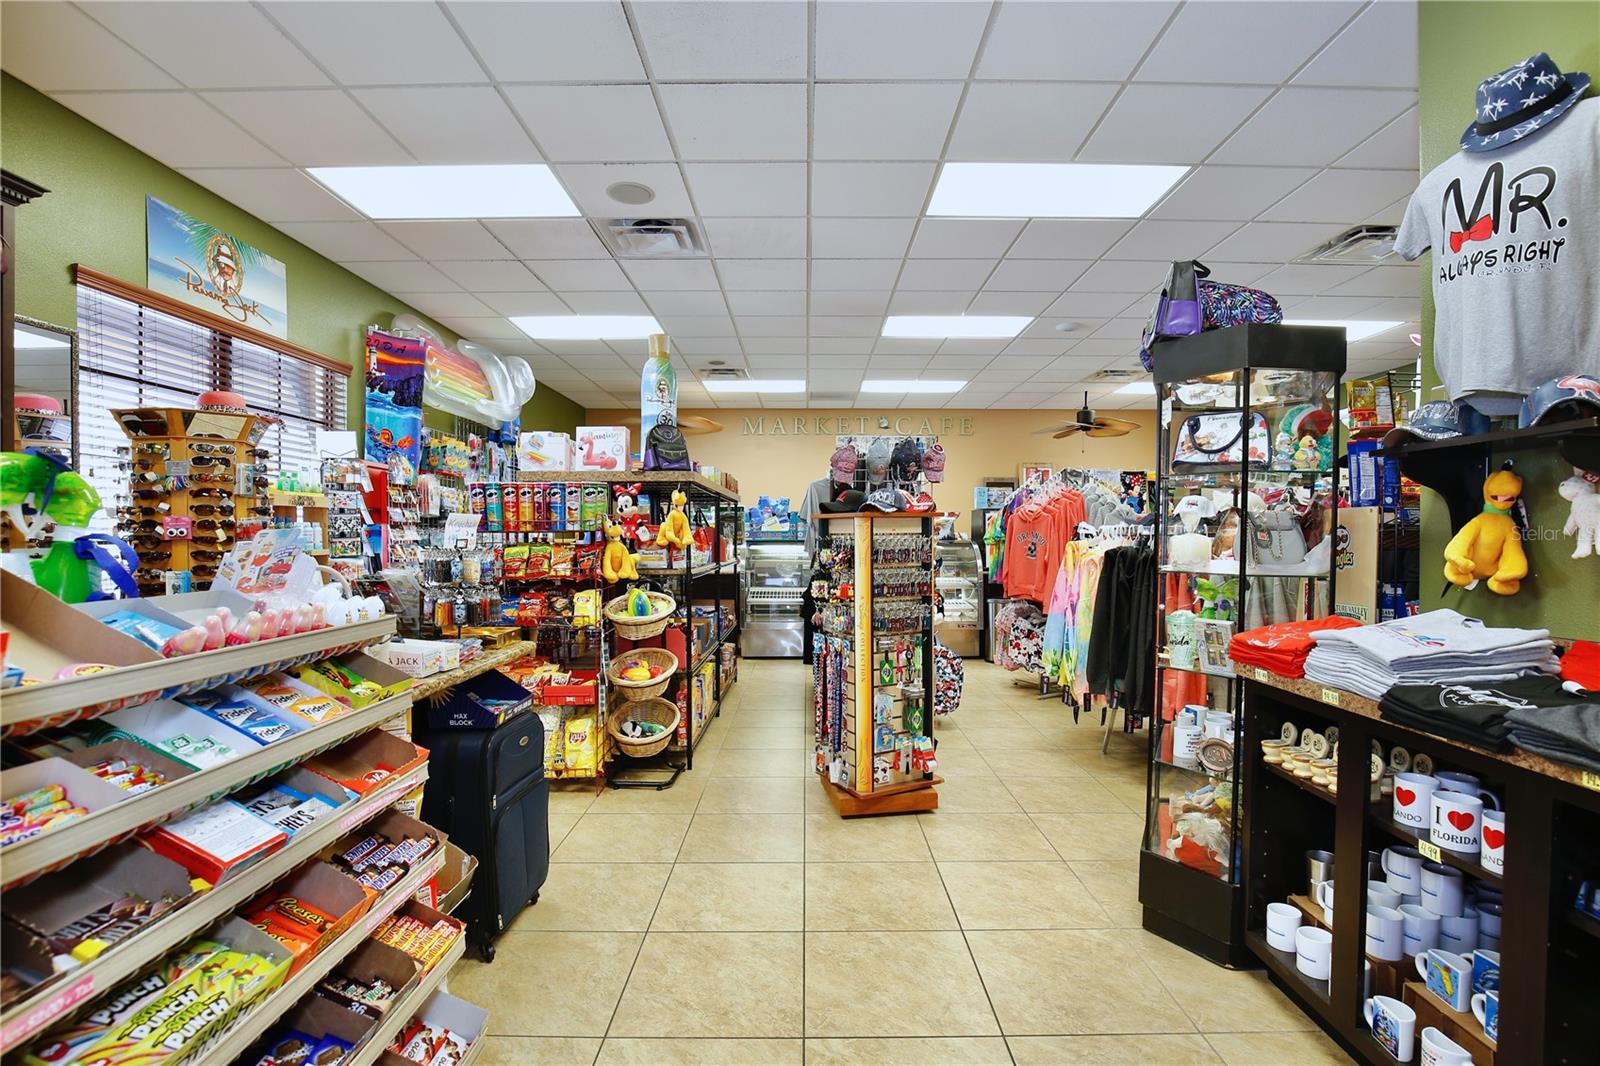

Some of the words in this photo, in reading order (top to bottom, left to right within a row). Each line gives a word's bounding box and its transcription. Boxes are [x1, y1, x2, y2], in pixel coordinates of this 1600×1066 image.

[1441, 160, 1568, 256] MR.
[1502, 237, 1566, 266] RIGHT
[742, 415, 872, 436] MARKET
[895, 415, 976, 437] CAFE
[1348, 606, 1368, 621] VALLEY
[395, 657, 420, 666] JACK
[268, 691, 301, 707] Trident
[299, 701, 334, 717] Trident
[217, 705, 257, 721] Trident
[252, 722, 290, 740] Trident
[1435, 805, 1442, 825] I
[1432, 828, 1479, 846] FLORIDA
[344, 837, 377, 862] SNICKERS
[277, 897, 324, 924] Reese's
[89, 974, 167, 1025] PUNCH
[131, 996, 170, 1025] SOUR
[351, 1001, 368, 1015] 36
[129, 989, 201, 1040] PUNCH
[163, 997, 231, 1050] PUNCH
[165, 1001, 205, 1032] SOUR
